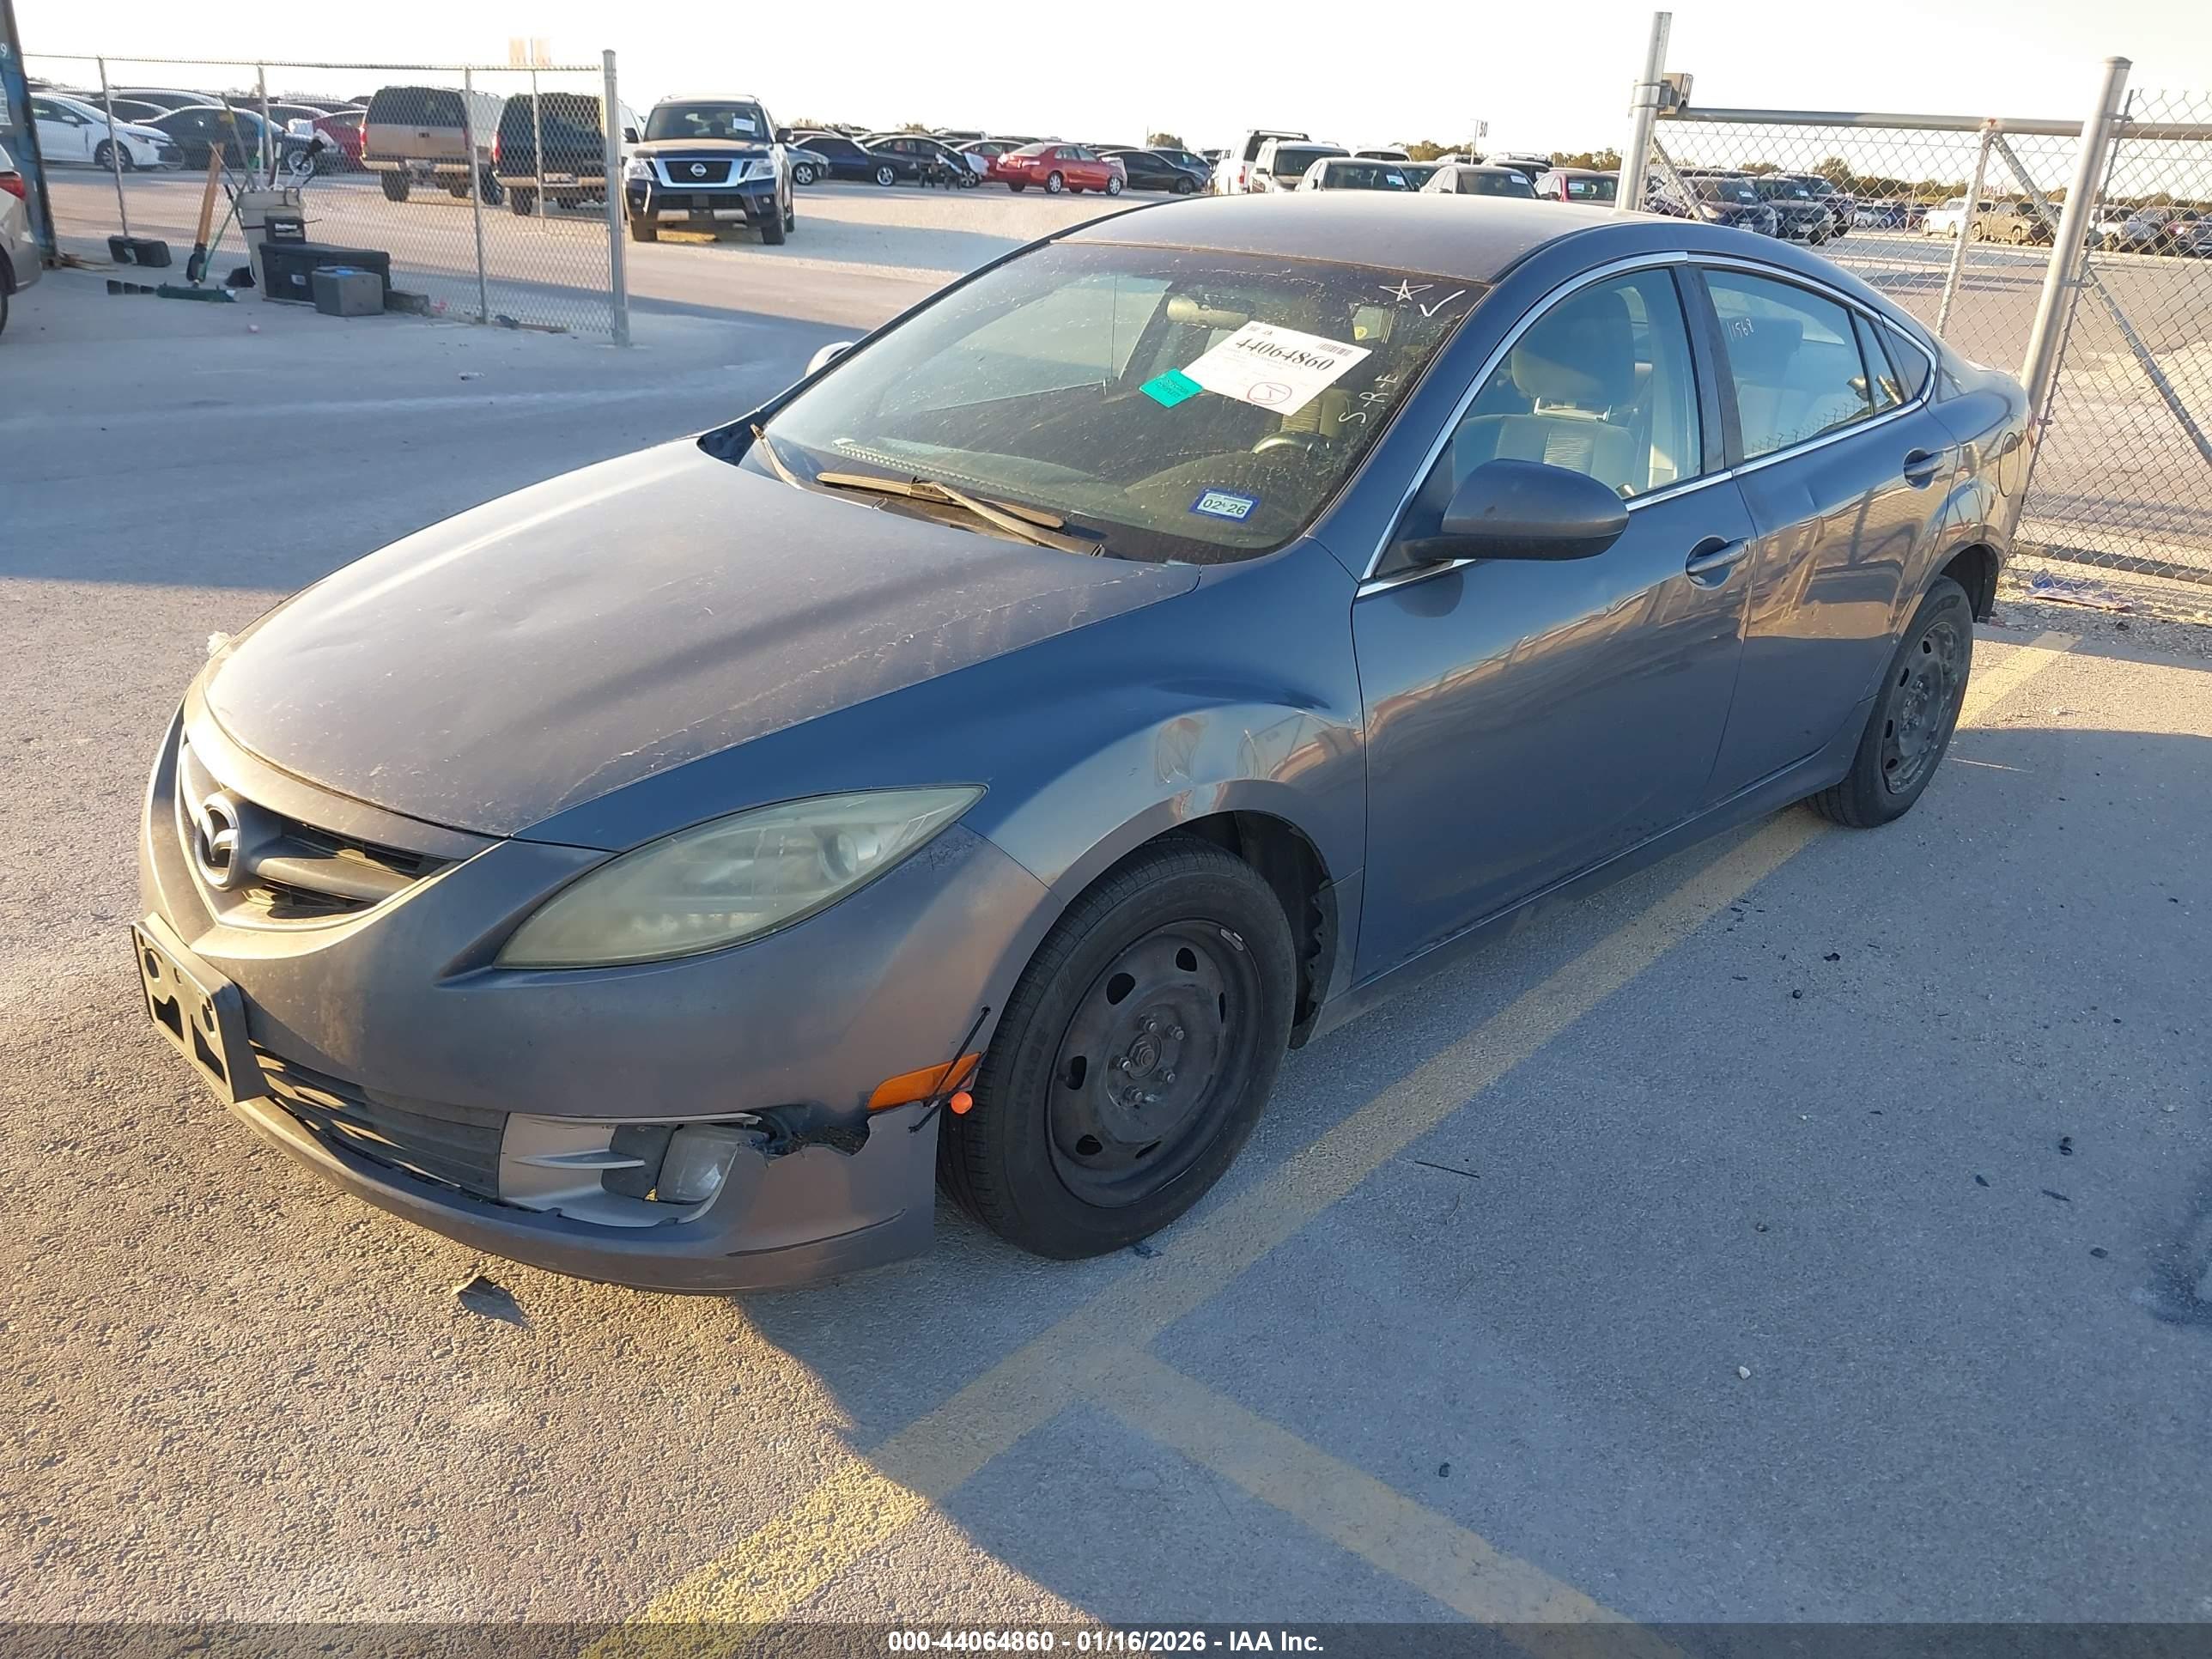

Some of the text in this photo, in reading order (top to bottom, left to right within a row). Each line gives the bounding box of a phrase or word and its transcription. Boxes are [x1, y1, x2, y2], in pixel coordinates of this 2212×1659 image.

[1479, 121, 1488, 138] 50
[1236, 337, 1335, 372] 44064860
[1202, 498, 1223, 511] 02
[1225, 503, 1248, 515] 26
